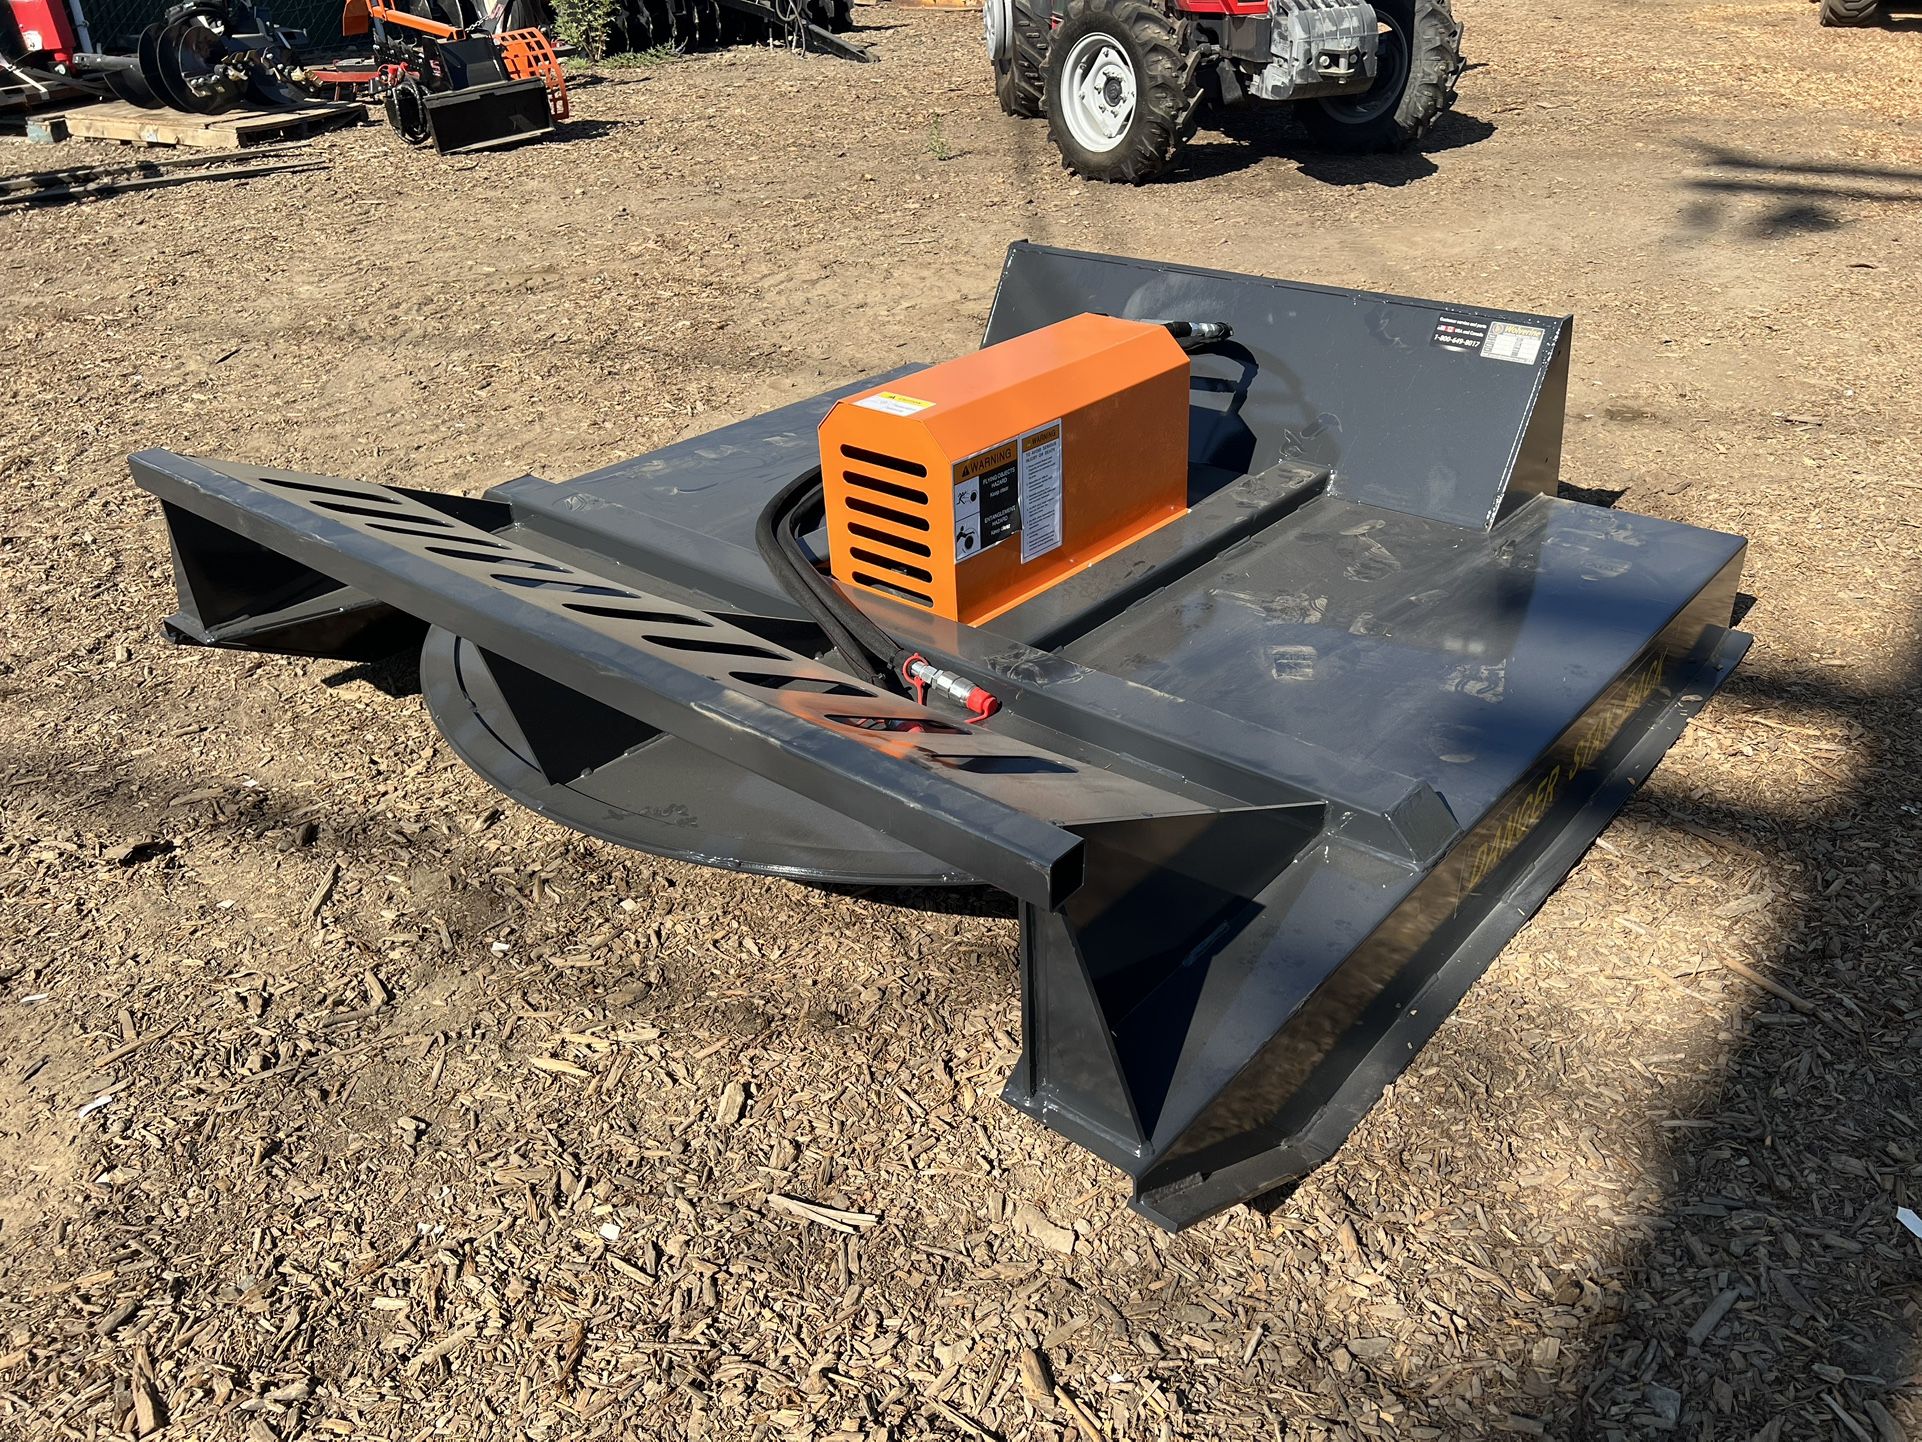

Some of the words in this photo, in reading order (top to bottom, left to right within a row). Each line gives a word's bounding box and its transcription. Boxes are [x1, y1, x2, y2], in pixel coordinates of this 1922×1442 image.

[1504, 324, 1542, 337] Wolverine
[1031, 429, 1056, 444] WARNING
[970, 448, 1012, 472] WARNING
[997, 467, 1016, 479] OBJECTS
[991, 477, 1008, 489] HAZARD
[984, 504, 1016, 524] ENTANGLEMENT
[992, 515, 1008, 526] HAZARD
[1468, 765, 1560, 890] DANGER
